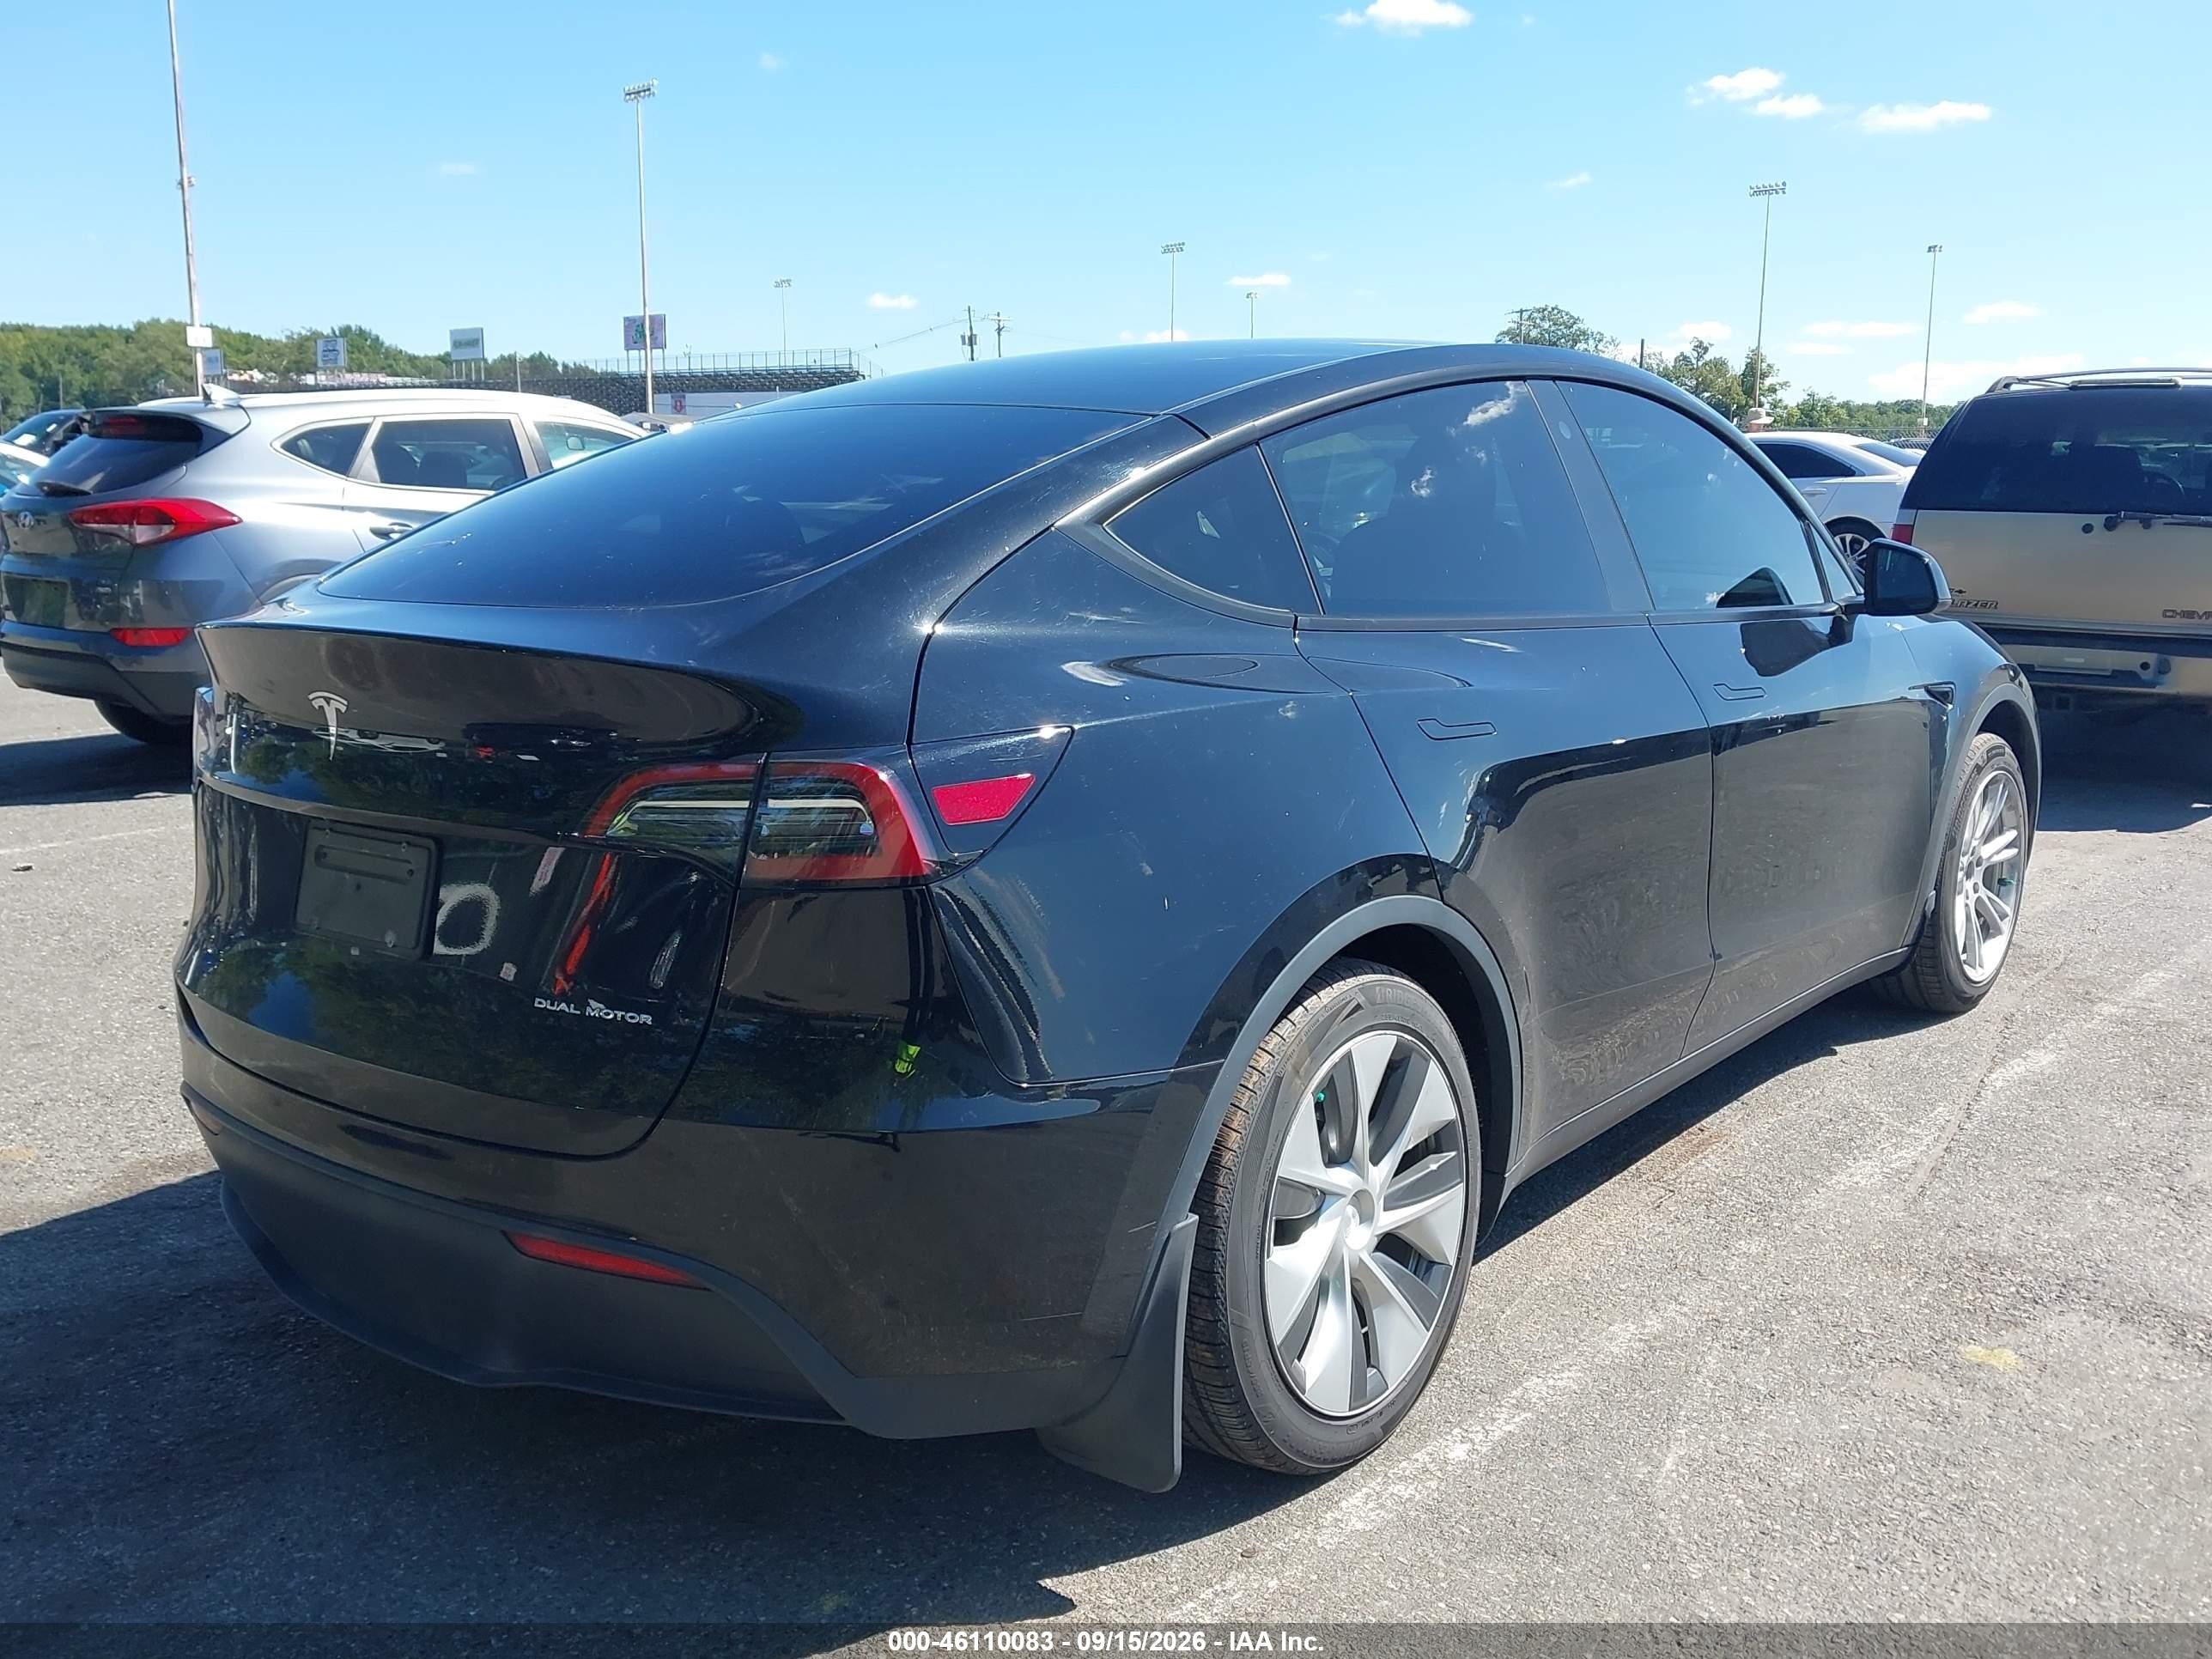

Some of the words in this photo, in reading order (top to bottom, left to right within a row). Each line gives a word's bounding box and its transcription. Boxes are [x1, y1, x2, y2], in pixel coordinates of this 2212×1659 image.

[1950, 599, 1999, 610] LAZER
[534, 997, 580, 1015] DUAL
[585, 1006, 653, 1025] MOTOR
